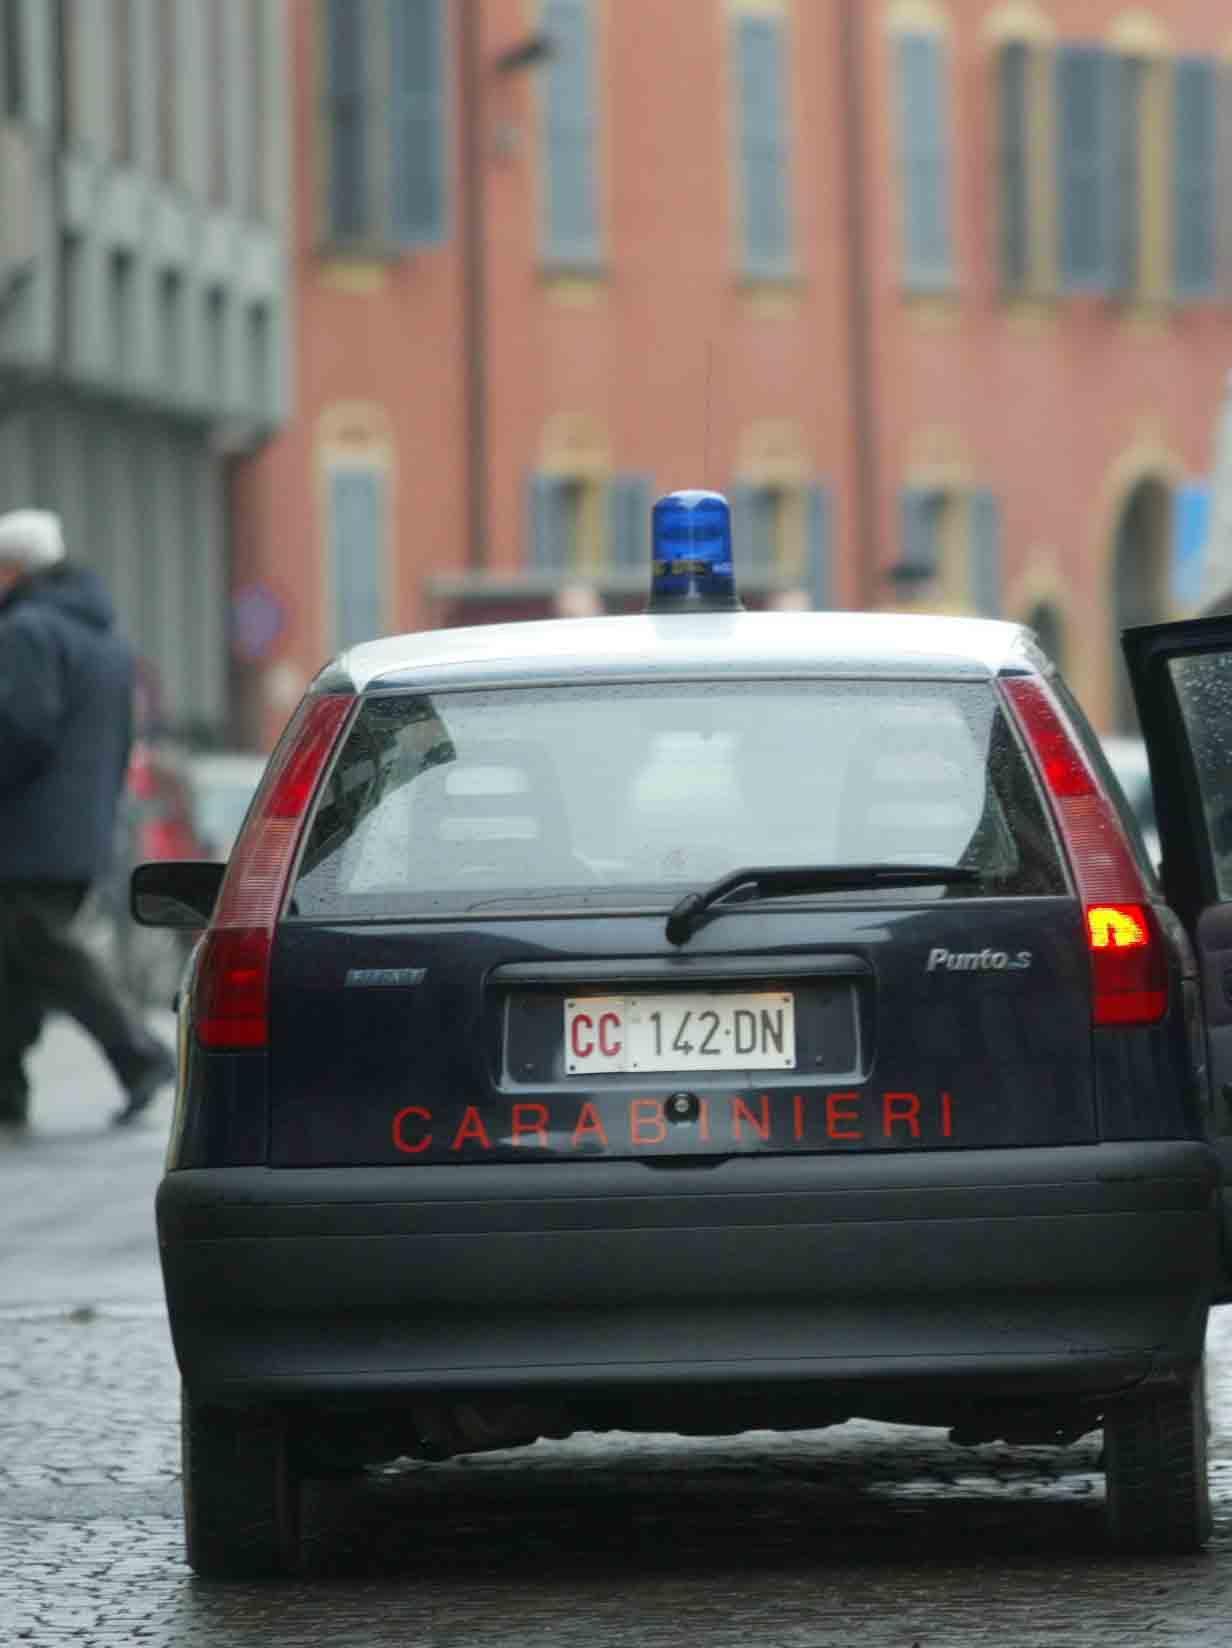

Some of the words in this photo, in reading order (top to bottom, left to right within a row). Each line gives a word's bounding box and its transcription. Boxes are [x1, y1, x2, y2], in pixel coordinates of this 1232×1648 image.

[927, 946, 1009, 971] Punto
[571, 1012, 622, 1058] CC
[391, 1092, 953, 1153] CARABINIERI
